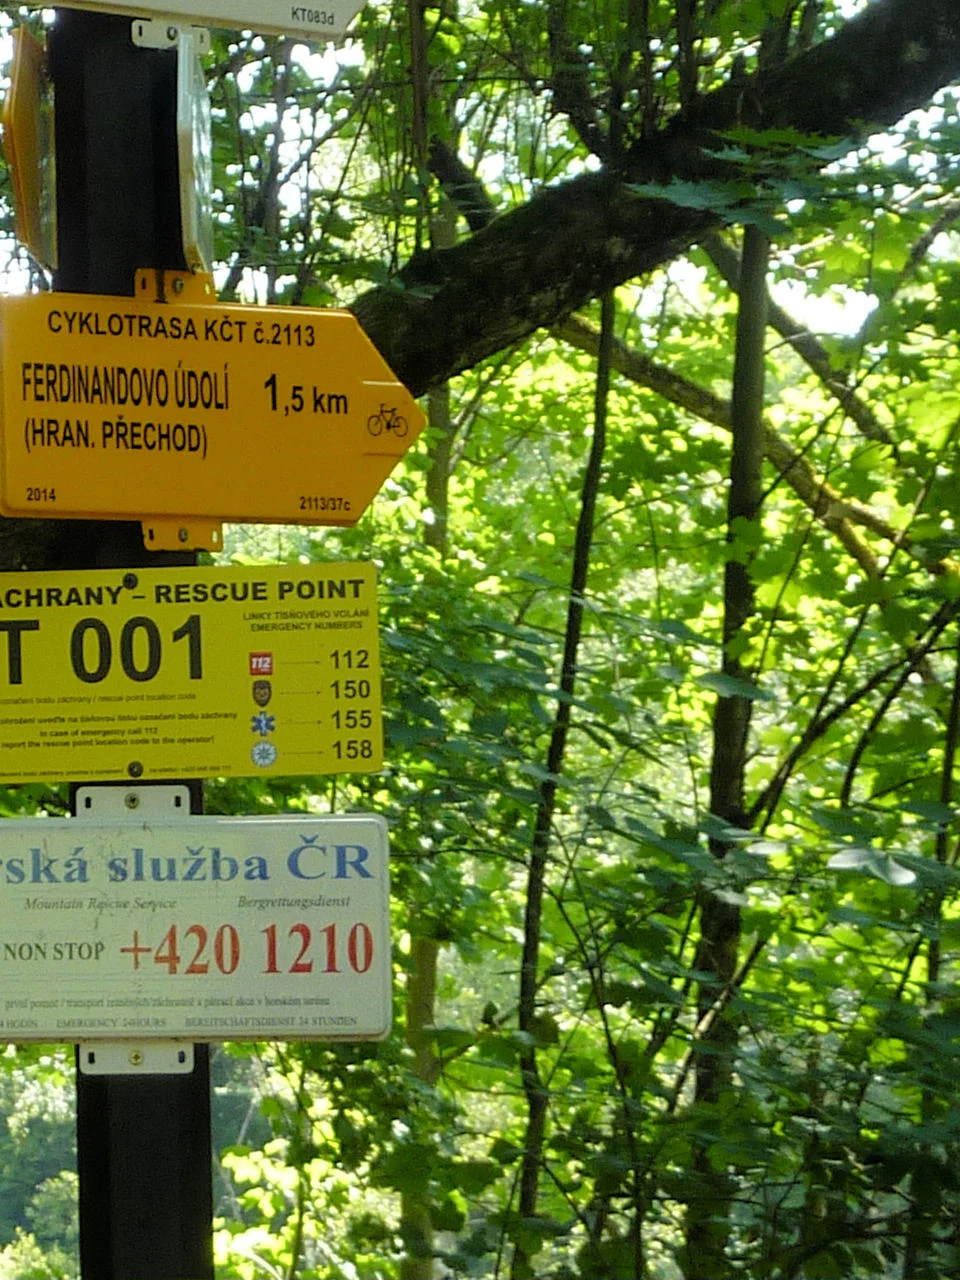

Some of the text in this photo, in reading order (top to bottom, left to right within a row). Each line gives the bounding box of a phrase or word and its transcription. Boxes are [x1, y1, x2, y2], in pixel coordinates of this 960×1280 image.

[291, 8, 335, 26] KT083d
[47, 311, 197, 341] CYKLOTRASA
[204, 315, 245, 343] KČT
[21, 361, 348, 416] FERDINANDOVO ÚDOLÍ 1,5 km
[24, 415, 208, 459] (HRAN. PŘECHOD)
[26, 487, 56, 502] 2014
[299, 496, 351, 512] 2113/37c
[154, 583, 268, 604] RESCUE
[278, 580, 365, 600] POINT
[242, 612, 271, 621] LINKY
[251, 620, 364, 632] EMERGENCY NUMBERS
[70, 614, 203, 684] 001
[251, 650, 369, 669] 112 112
[331, 681, 371, 699] 150
[331, 711, 372, 730] 155
[332, 741, 373, 760] 158
[108, 846, 270, 883] služba
[287, 835, 375, 880] ČR
[23, 895, 351, 911] Mountain Rescue Service Bergrettungsdienst
[3, 922, 375, 974] NON STOP +420 1210
